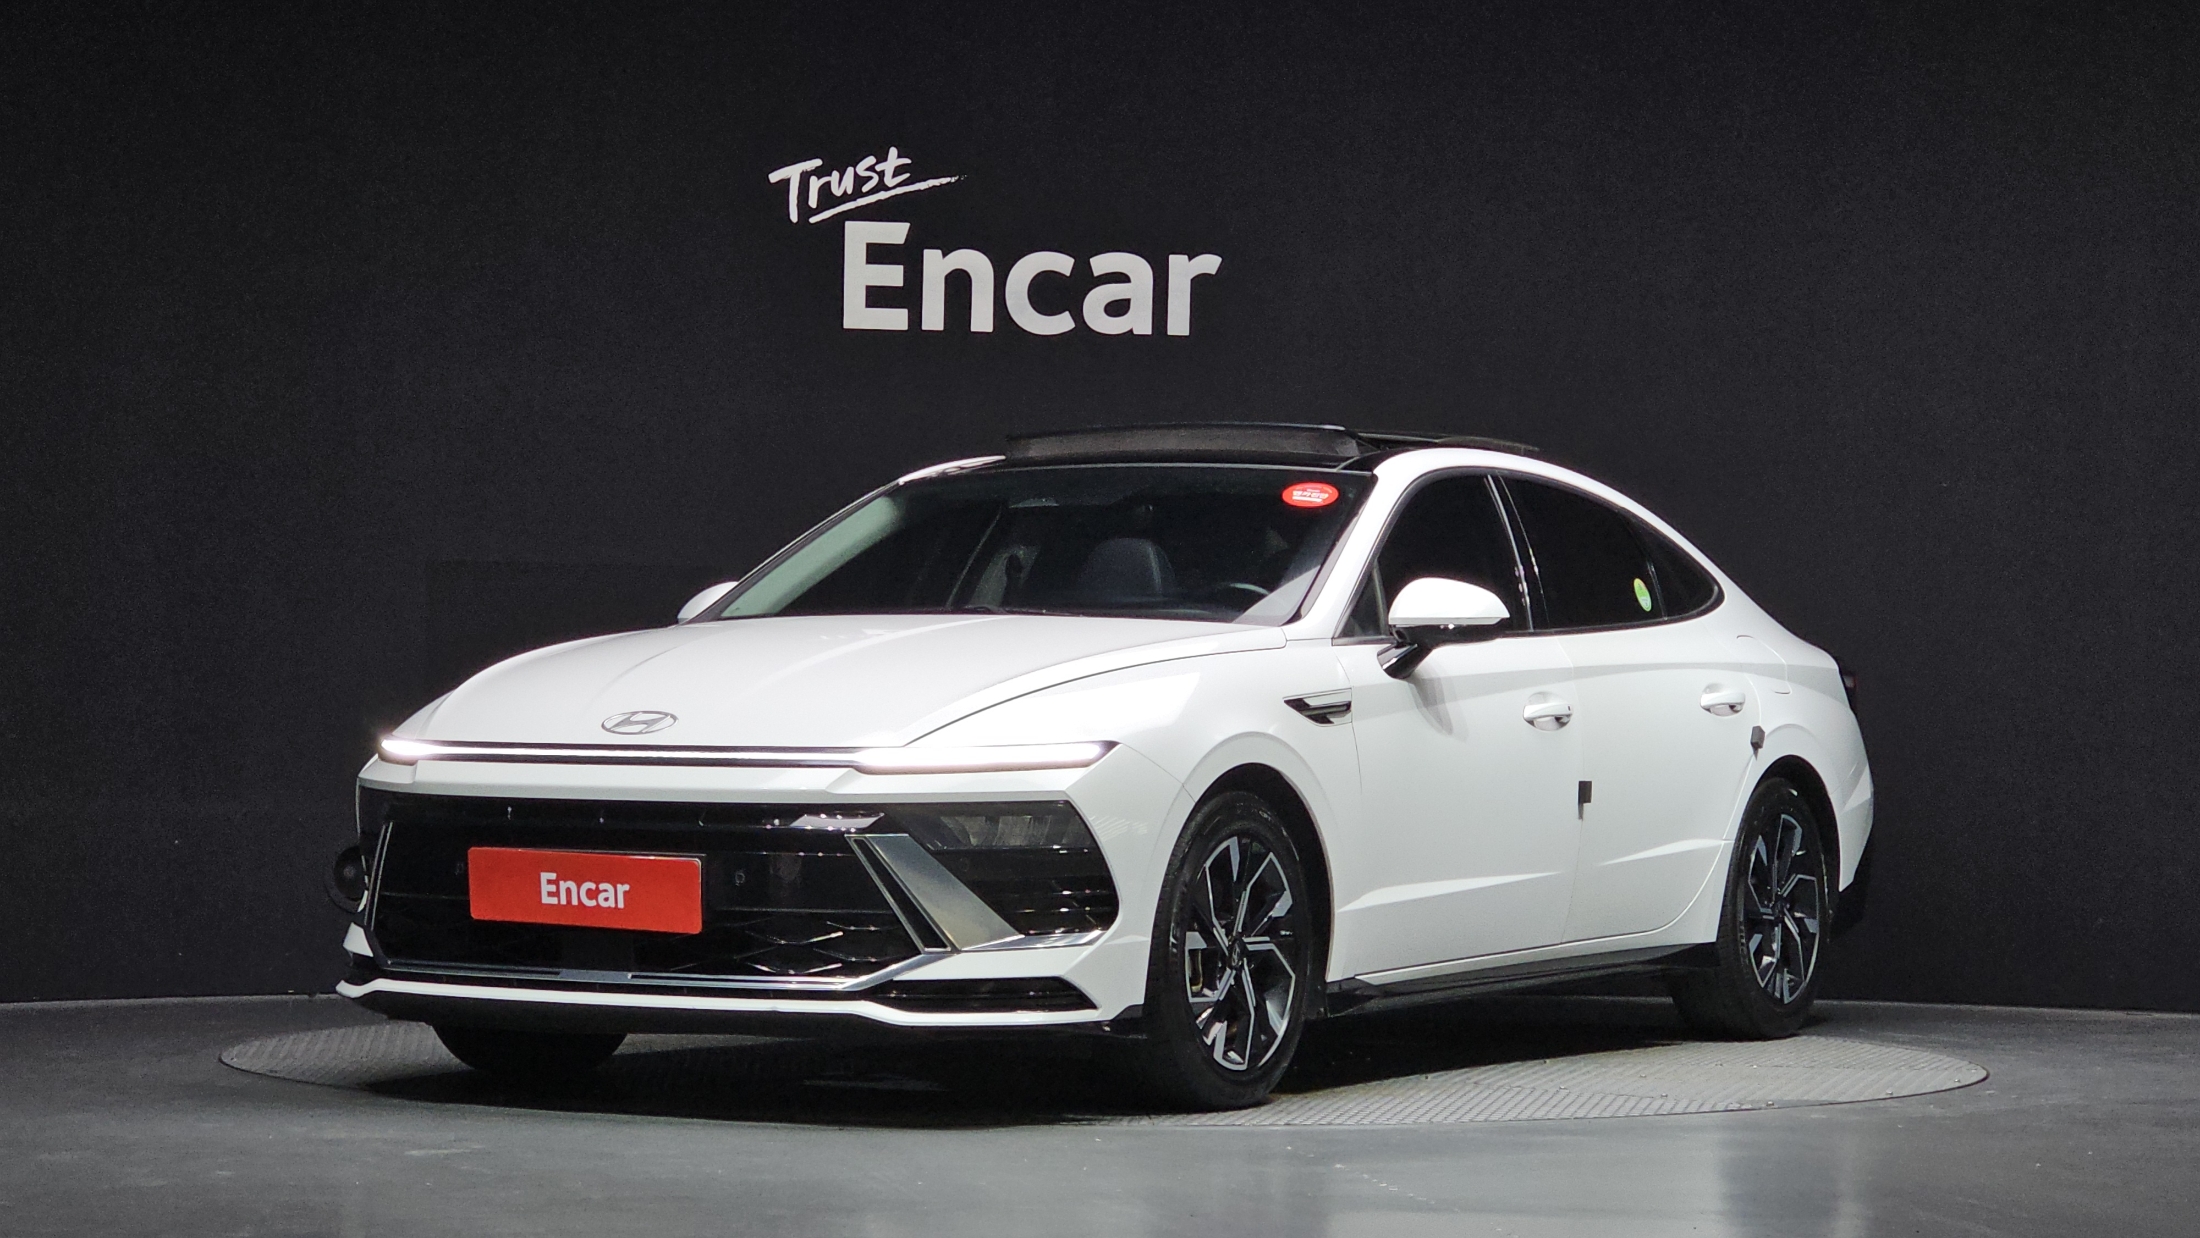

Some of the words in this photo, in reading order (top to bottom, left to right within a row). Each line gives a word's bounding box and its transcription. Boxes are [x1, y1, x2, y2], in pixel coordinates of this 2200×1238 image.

[768, 146, 912, 223] Trust
[842, 220, 1223, 336] Encar
[539, 871, 631, 909] Encar
